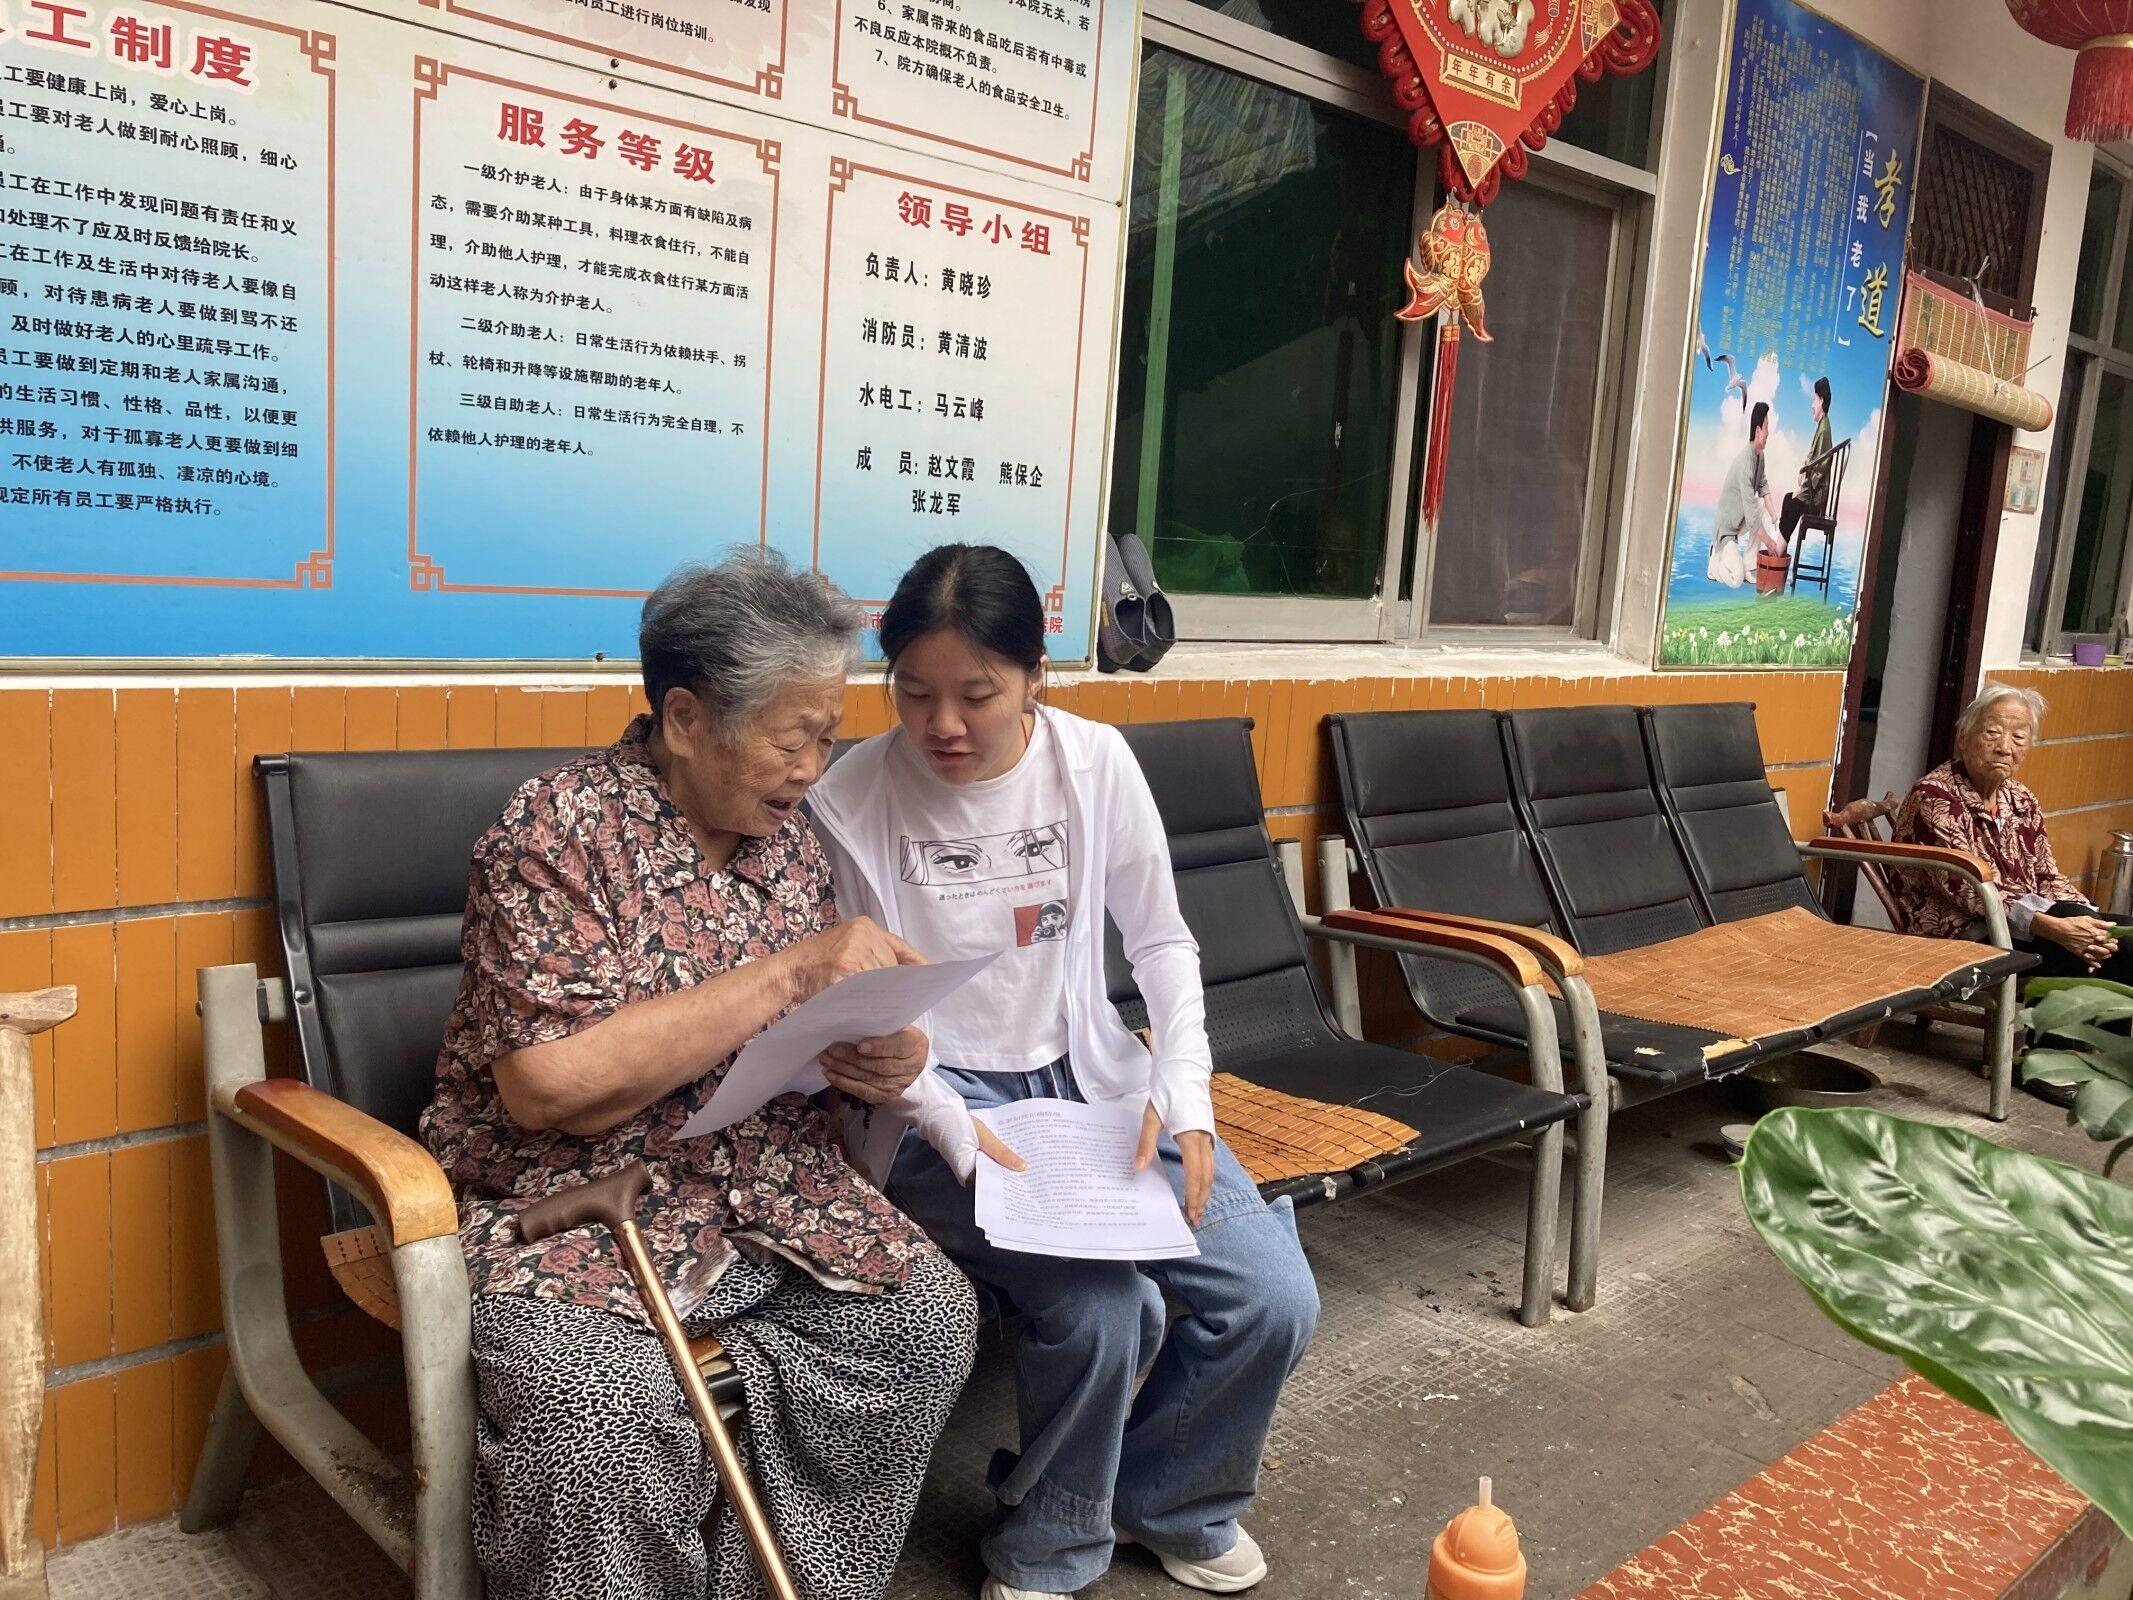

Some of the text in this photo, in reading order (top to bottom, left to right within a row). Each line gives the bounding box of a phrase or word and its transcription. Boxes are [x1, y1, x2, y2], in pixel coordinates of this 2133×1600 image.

[565, 0, 714, 43] 员工进行岗位培训。
[731, 0, 771, 13] 发现
[998, 0, 1091, 32] 本院无关，若
[0, 1, 252, 87] 工制度
[853, 15, 998, 75] 不良反应本院概不负责。
[0, 65, 237, 126] 工要健康上岗，爱心上岗。
[874, 49, 1071, 121] 7、院方确保老人的食品安全卫生。
[1452, 58, 1512, 94] 年年有余
[497, 102, 717, 185] 服务等级
[463, 163, 752, 231] 一级介护老人：由于身体某方面有缺陷及病
[0, 208, 258, 264] 处理不了应及时反馈给院长。
[430, 194, 750, 265] 态，需要介助某种工具，料理衣食住行，不能自
[897, 190, 1051, 256] 领导小组
[429, 233, 749, 300] 理，介助他人护理，才能完成衣食住行某方面活
[865, 251, 992, 299] 负责人：黄晓珍
[429, 272, 613, 315] 动这样老人称为介护老人。
[11, 314, 279, 363] 及时做好老人的心里疏导工作。
[460, 316, 747, 369] 二级介助老人：日常生活行为依赖扶手、拐
[862, 317, 988, 361] 消防员：黄清波
[428, 350, 683, 396] 杖、轮椅和升降等设施帮助的老年人。
[459, 392, 745, 437] 三级自助老人：日常生活行为完全自理，不
[858, 382, 985, 422] 水电工：马云峰
[427, 427, 594, 457] 依赖他人护理的老年人。
[11, 453, 279, 489] 不使老人有孤独、凄凉的心境。
[912, 489, 961, 517] 张龙军
